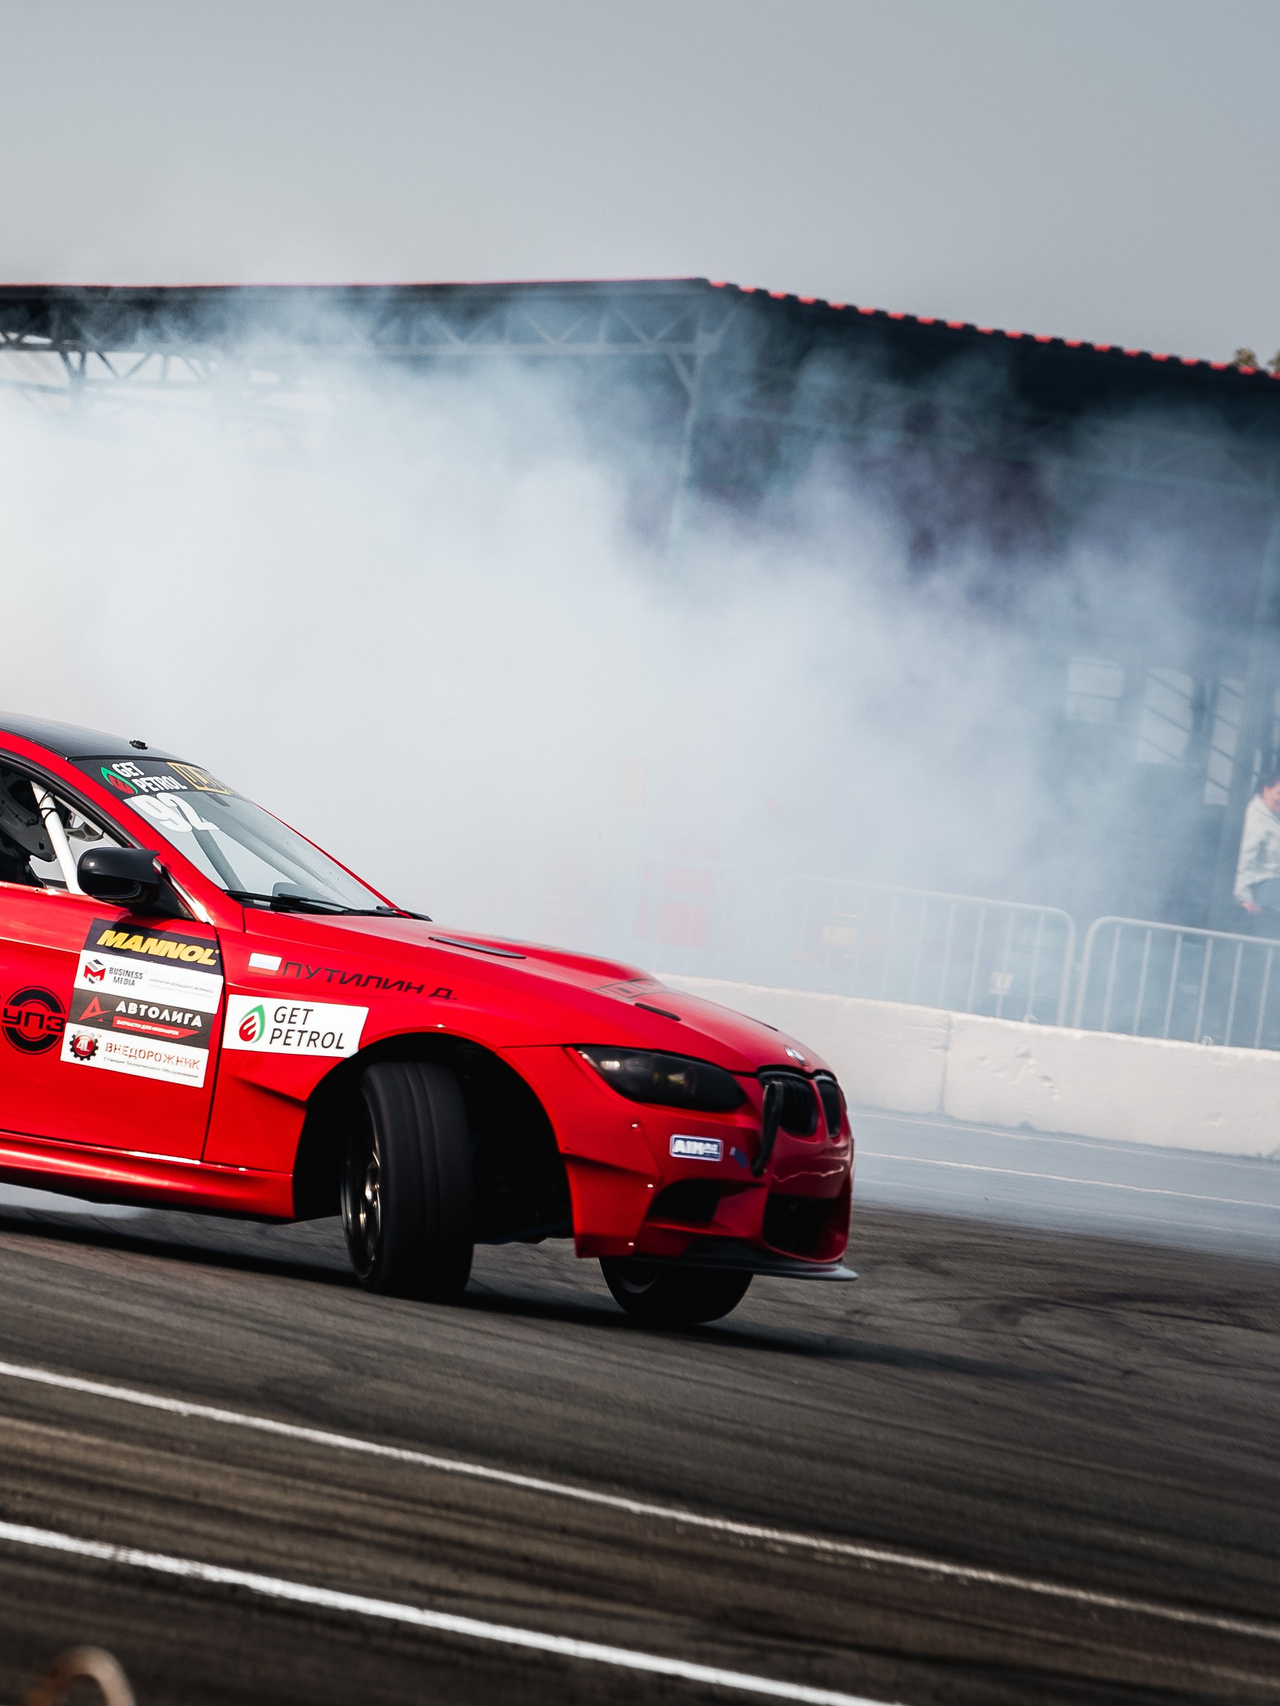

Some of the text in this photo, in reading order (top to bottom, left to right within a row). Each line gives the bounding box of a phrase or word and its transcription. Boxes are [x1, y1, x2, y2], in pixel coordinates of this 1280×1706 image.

[112, 762, 144, 778] GET
[131, 776, 188, 793] PETROL
[123, 792, 220, 832] 92
[96, 929, 217, 966] MANNOL
[109, 967, 143, 980] BUSINESS
[113, 976, 136, 987] MEDIA
[283, 961, 425, 994] ПУТИЛИН
[2, 1008, 66, 1032] УПЗ
[115, 1000, 202, 1028] АВТОЛИГА
[273, 1005, 314, 1026] GET
[269, 1028, 346, 1050] PETROL
[104, 1042, 200, 1070] ВНЕДОРОЖНИК
